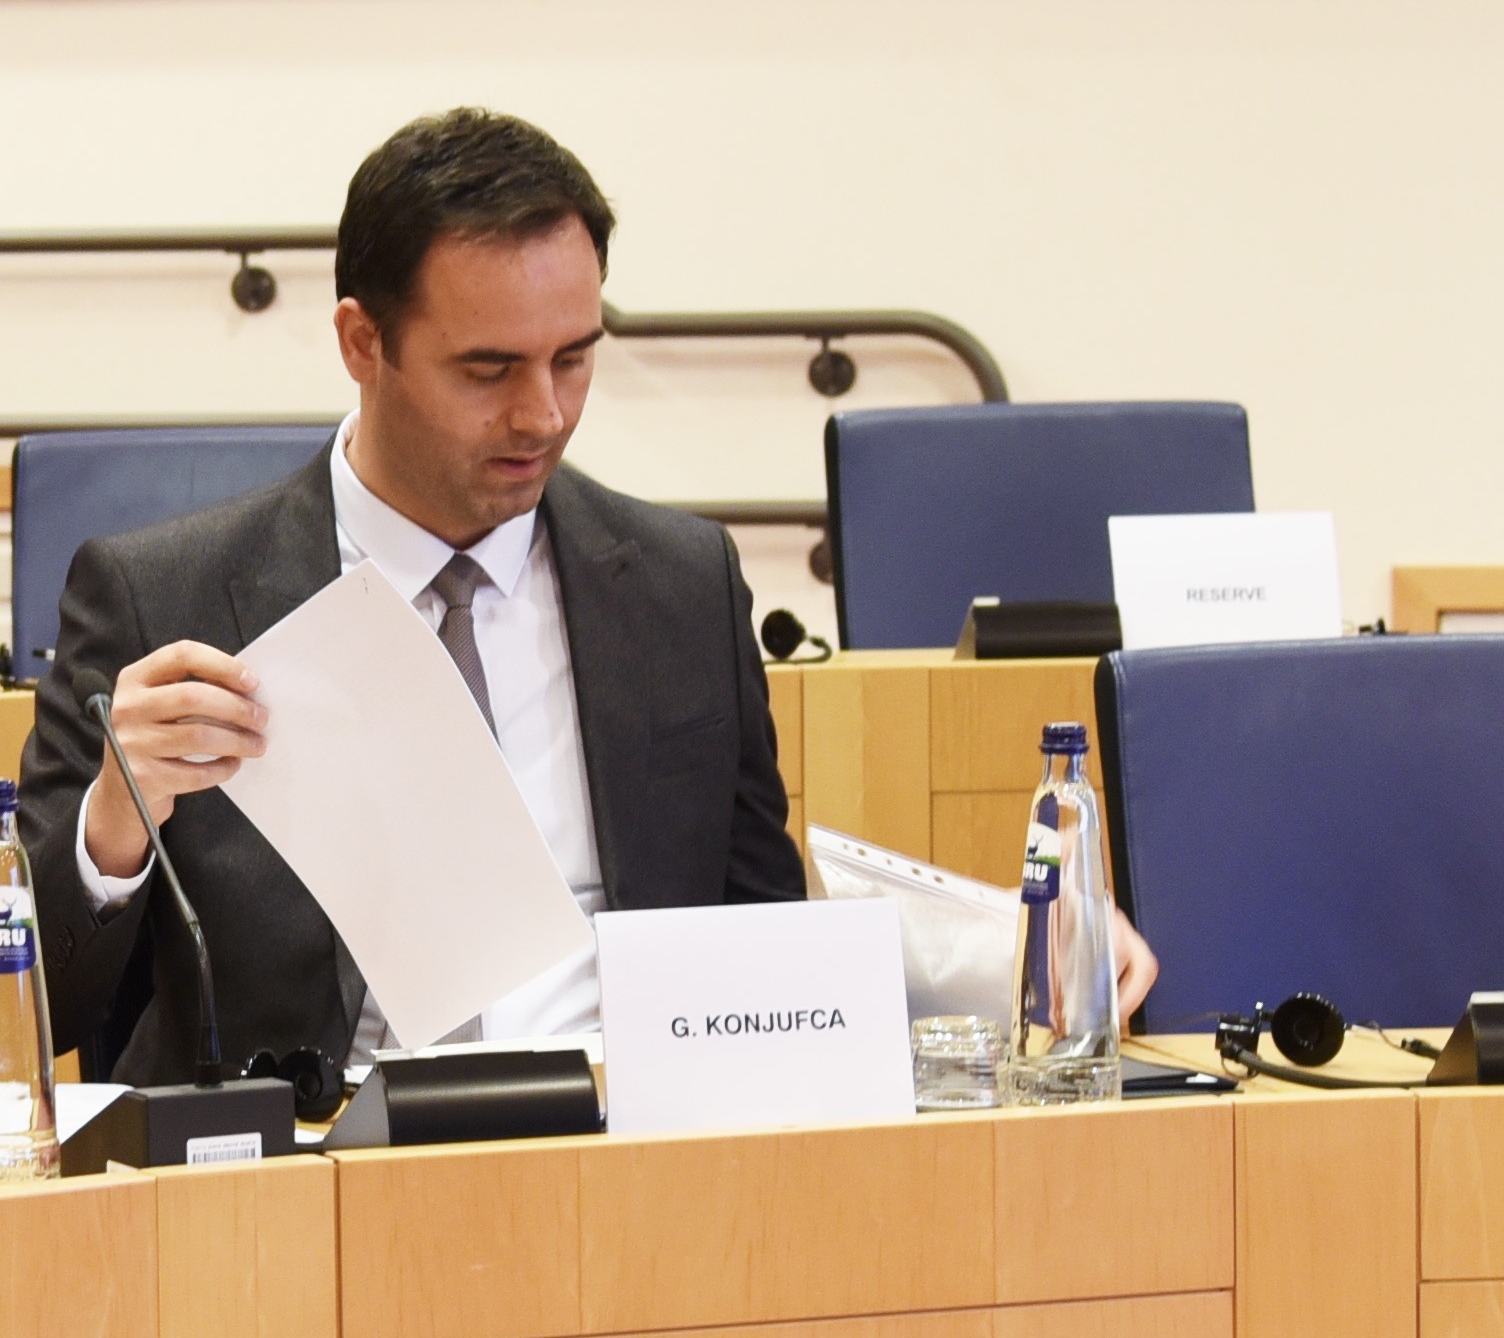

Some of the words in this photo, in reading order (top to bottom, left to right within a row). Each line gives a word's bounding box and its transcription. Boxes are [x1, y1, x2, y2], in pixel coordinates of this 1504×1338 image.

[1186, 585, 1266, 603] RESERVE
[1024, 861, 1049, 882] RU
[670, 1017, 697, 1038] G.
[706, 1008, 847, 1036] KONJUFCA
